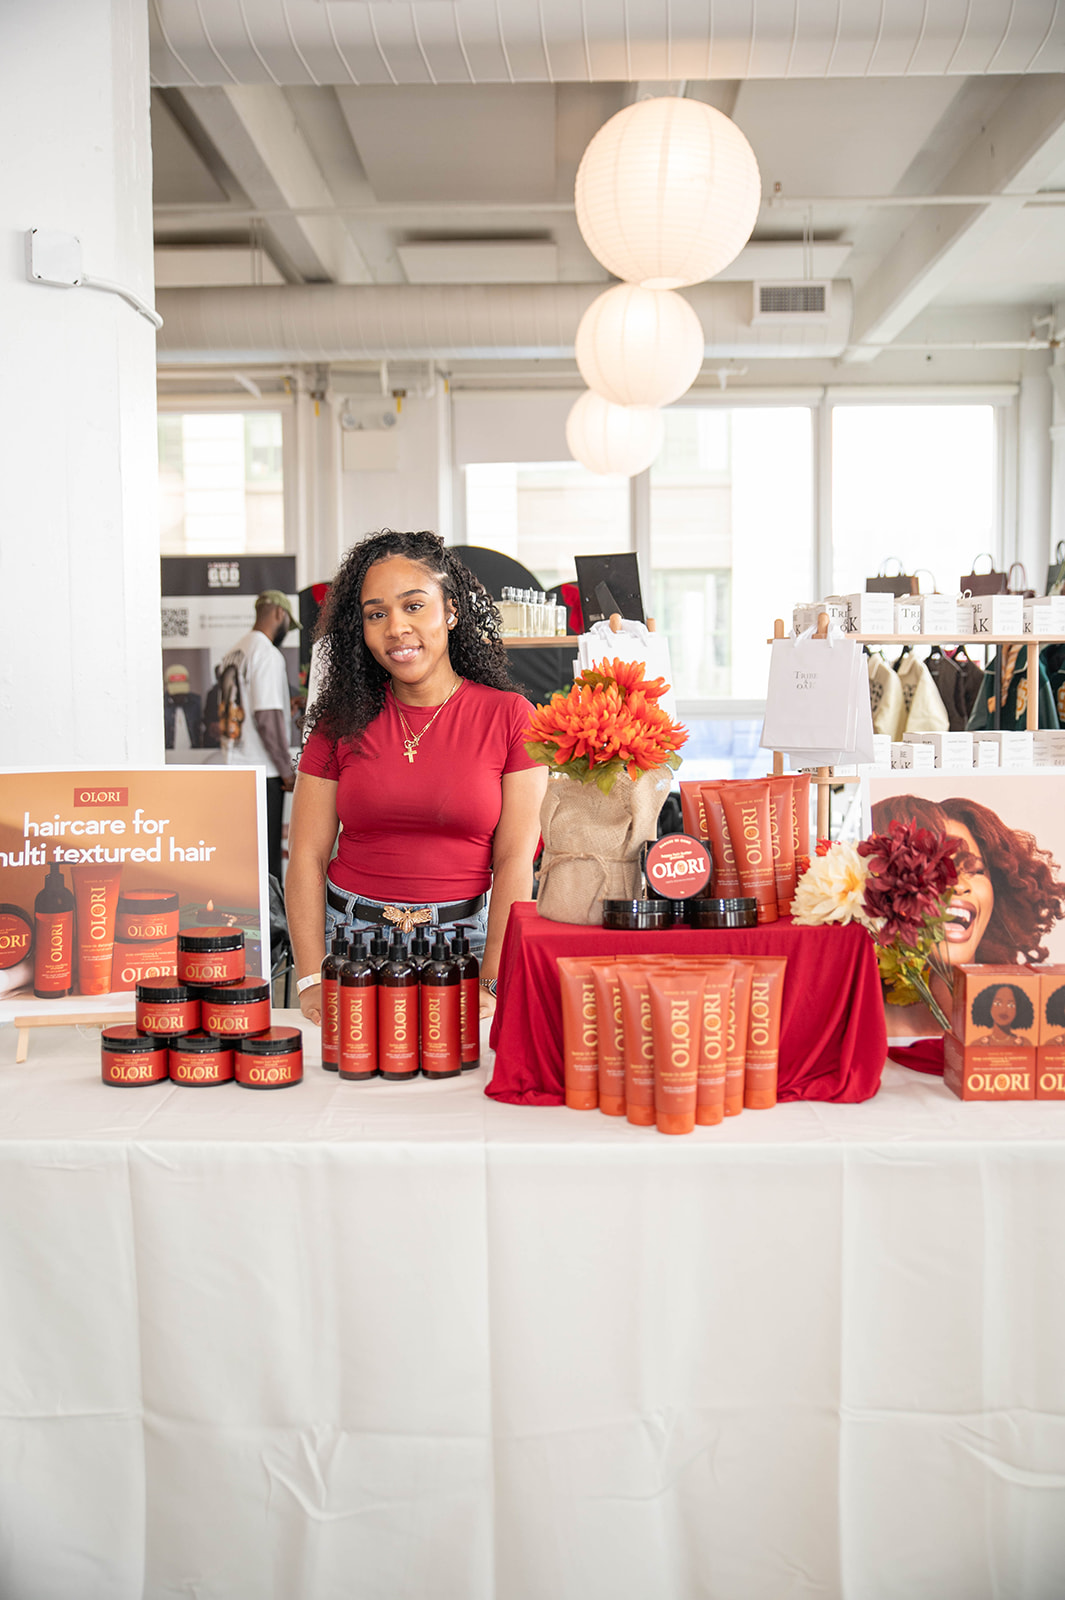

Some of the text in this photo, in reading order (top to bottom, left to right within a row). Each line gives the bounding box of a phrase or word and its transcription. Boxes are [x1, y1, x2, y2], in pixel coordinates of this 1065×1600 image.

[80, 791, 121, 803] OLORI
[24, 808, 170, 838] haircare for
[741, 807, 762, 866] OLORI
[53, 836, 161, 863] textured
[169, 836, 217, 862] hair
[652, 857, 706, 879] OLORI
[91, 886, 107, 941] OLORI
[51, 923, 64, 962] OLORI
[128, 924, 168, 938] OLORI
[121, 965, 178, 983] OLORI
[185, 964, 228, 979] OLORI
[142, 1015, 184, 1029] OLORI
[208, 1017, 249, 1031] OLORI
[350, 998, 363, 1042] OLORI
[394, 998, 407, 1042] OLORI
[428, 997, 441, 1041] OLORI
[751, 981, 770, 1046] OLORI
[671, 1000, 691, 1068] OLORI
[703, 992, 722, 1060] OLORI
[110, 1065, 153, 1080] OLORI
[177, 1065, 219, 1080] OLORI
[249, 1066, 292, 1082] OLORI
[967, 1073, 1031, 1093] OLORI
